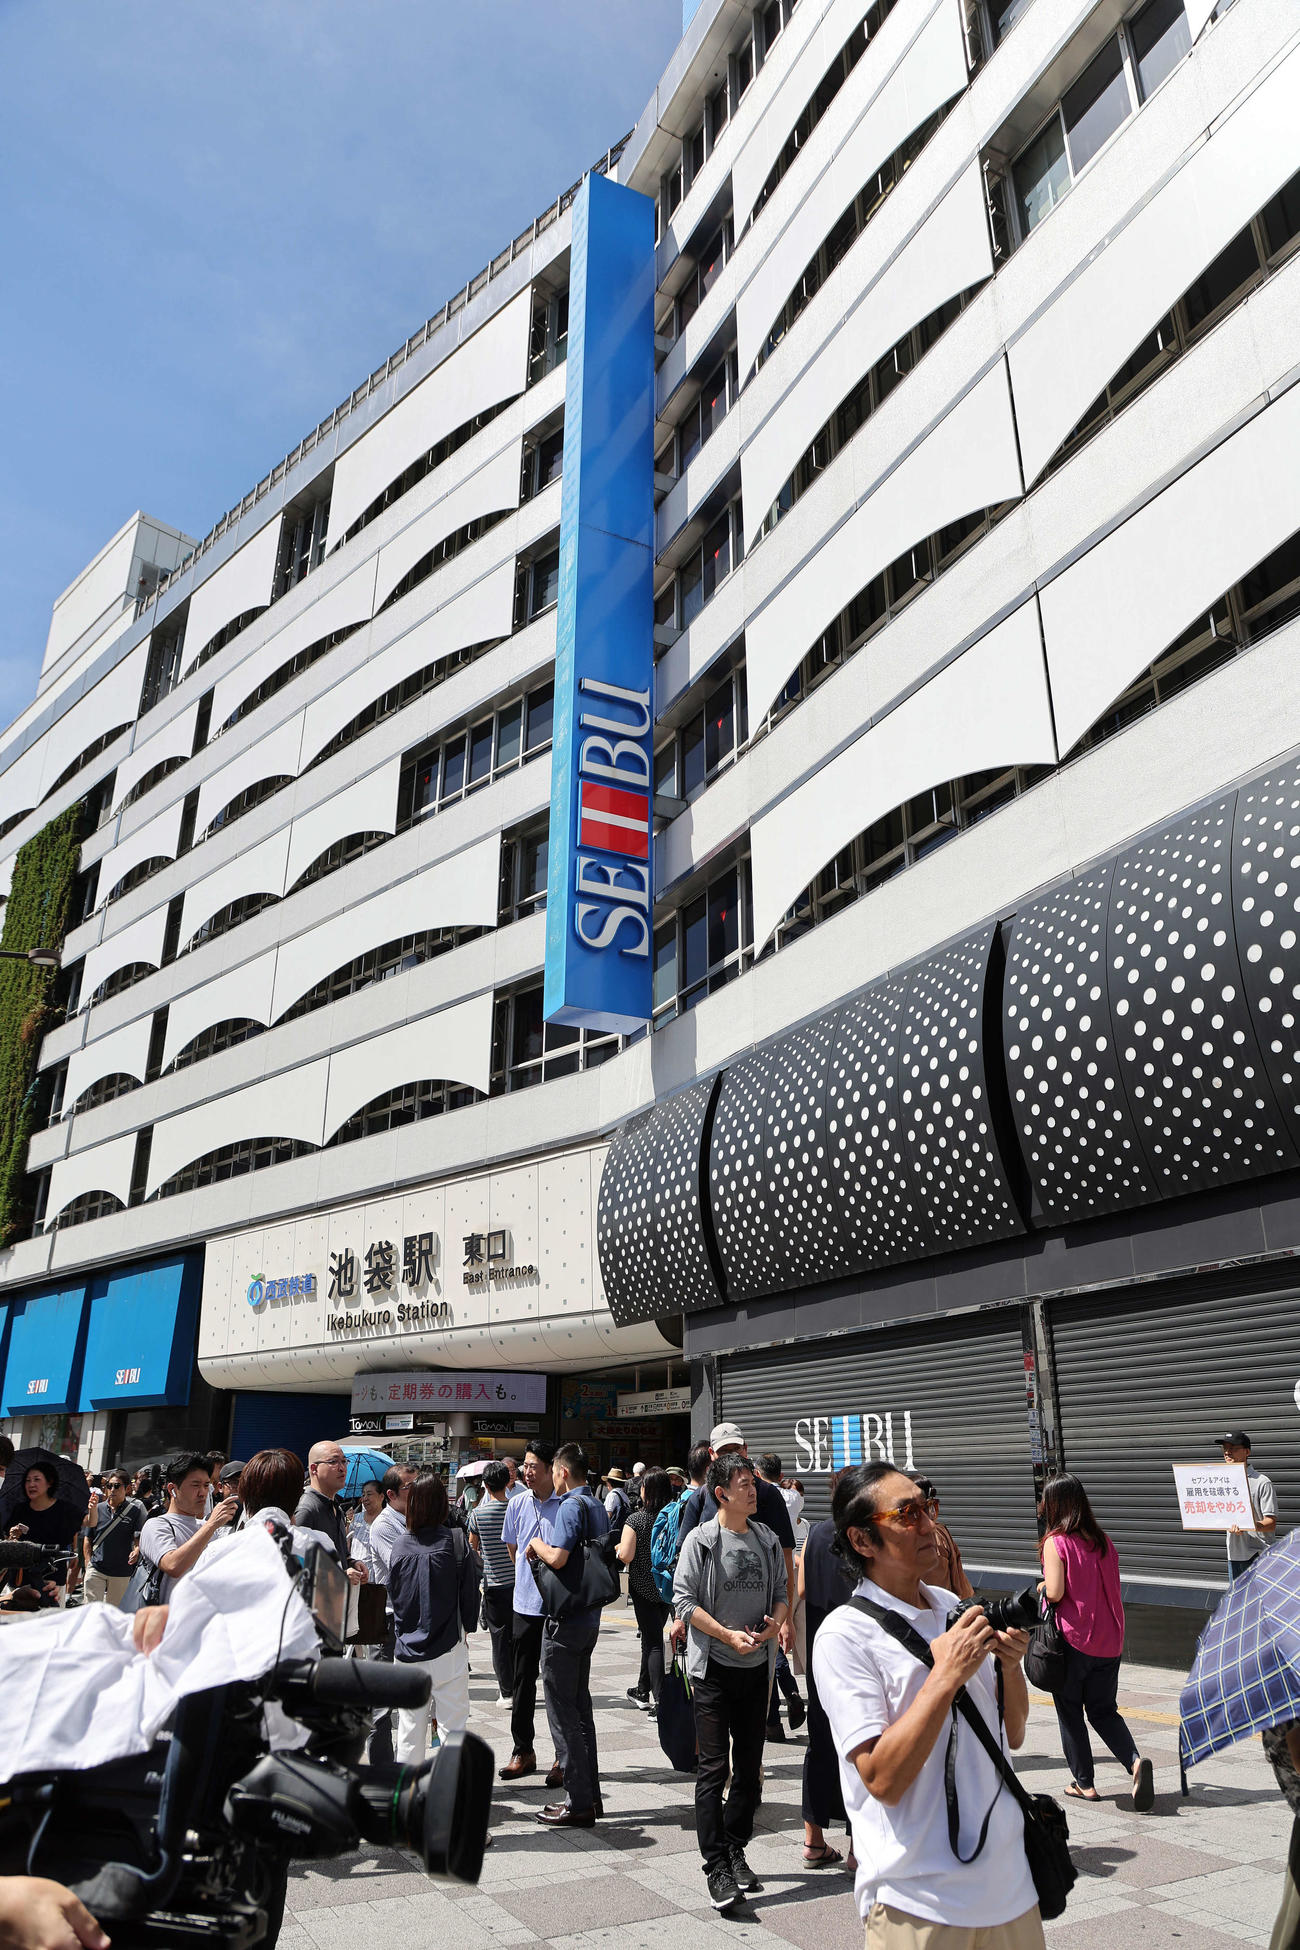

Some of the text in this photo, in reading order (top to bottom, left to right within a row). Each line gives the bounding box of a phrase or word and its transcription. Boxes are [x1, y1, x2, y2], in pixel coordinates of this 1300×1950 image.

[577, 677, 650, 957] SEIBU
[463, 1229, 507, 1267] 東口
[328, 1231, 435, 1300] 池袋駅
[463, 1264, 535, 1285] East Entrance
[265, 1273, 313, 1300] 西武鉄道
[327, 1300, 449, 1331] Ikebukuro Station
[26, 1379, 49, 1394] SEIBU
[115, 1367, 141, 1385] SEIBU
[1186, 1487, 1240, 1497] 雇用を破壊する
[1184, 1501, 1246, 1514] 売却をやめろ
